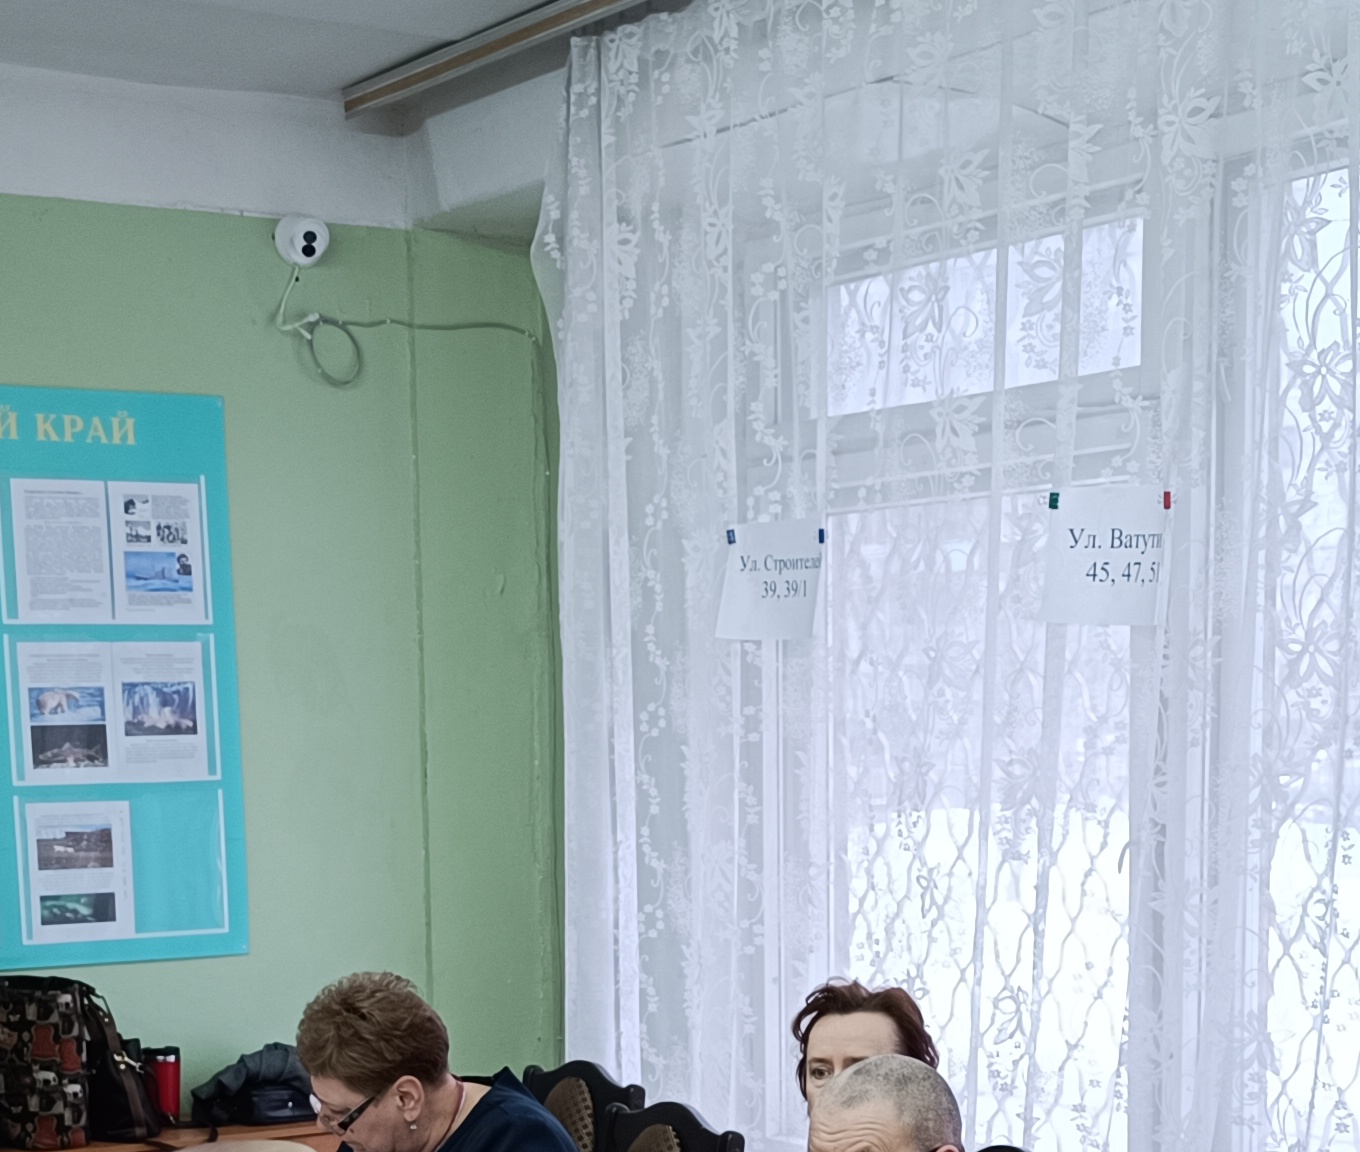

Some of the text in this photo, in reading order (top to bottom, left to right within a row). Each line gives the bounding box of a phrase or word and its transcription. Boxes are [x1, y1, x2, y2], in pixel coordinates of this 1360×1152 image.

[35, 410, 137, 446] КРАЙ
[1068, 528, 1102, 549] Ул.
[740, 555, 760, 572] Ул.
[1085, 561, 1116, 587] 45,
[1121, 561, 1145, 587] 47,
[761, 580, 780, 601] 39,
